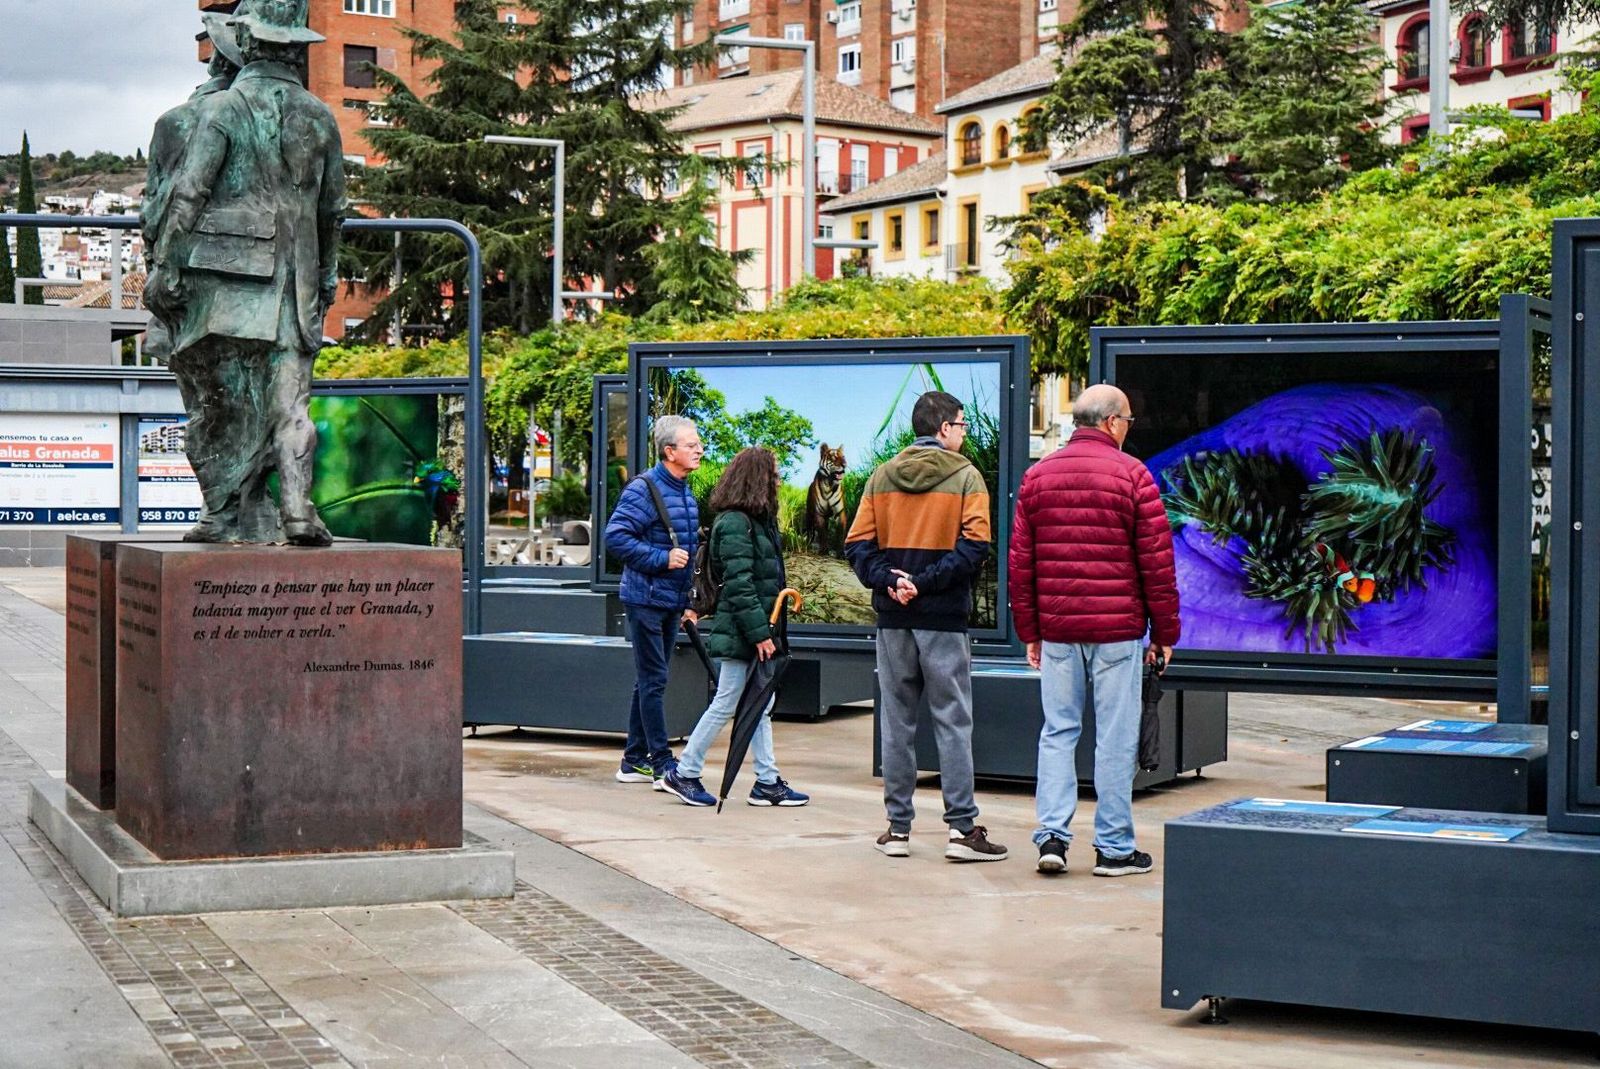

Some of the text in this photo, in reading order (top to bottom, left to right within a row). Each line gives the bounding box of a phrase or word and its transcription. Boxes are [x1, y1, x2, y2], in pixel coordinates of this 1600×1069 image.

[0, 446, 100, 460] alus Granada
[13, 511, 34, 521] 370
[57, 510, 107, 521] aelca.es
[141, 510, 201, 521] 958 870 87
[194, 578, 434, 598] “Empiezo a pensar que hay un placer
[192, 601, 434, 621] todavía mayor que el ver Granada, y
[193, 624, 346, 640] es el de volver a verla.”
[303, 661, 360, 672] Alexandre
[409, 659, 434, 671] 1846
